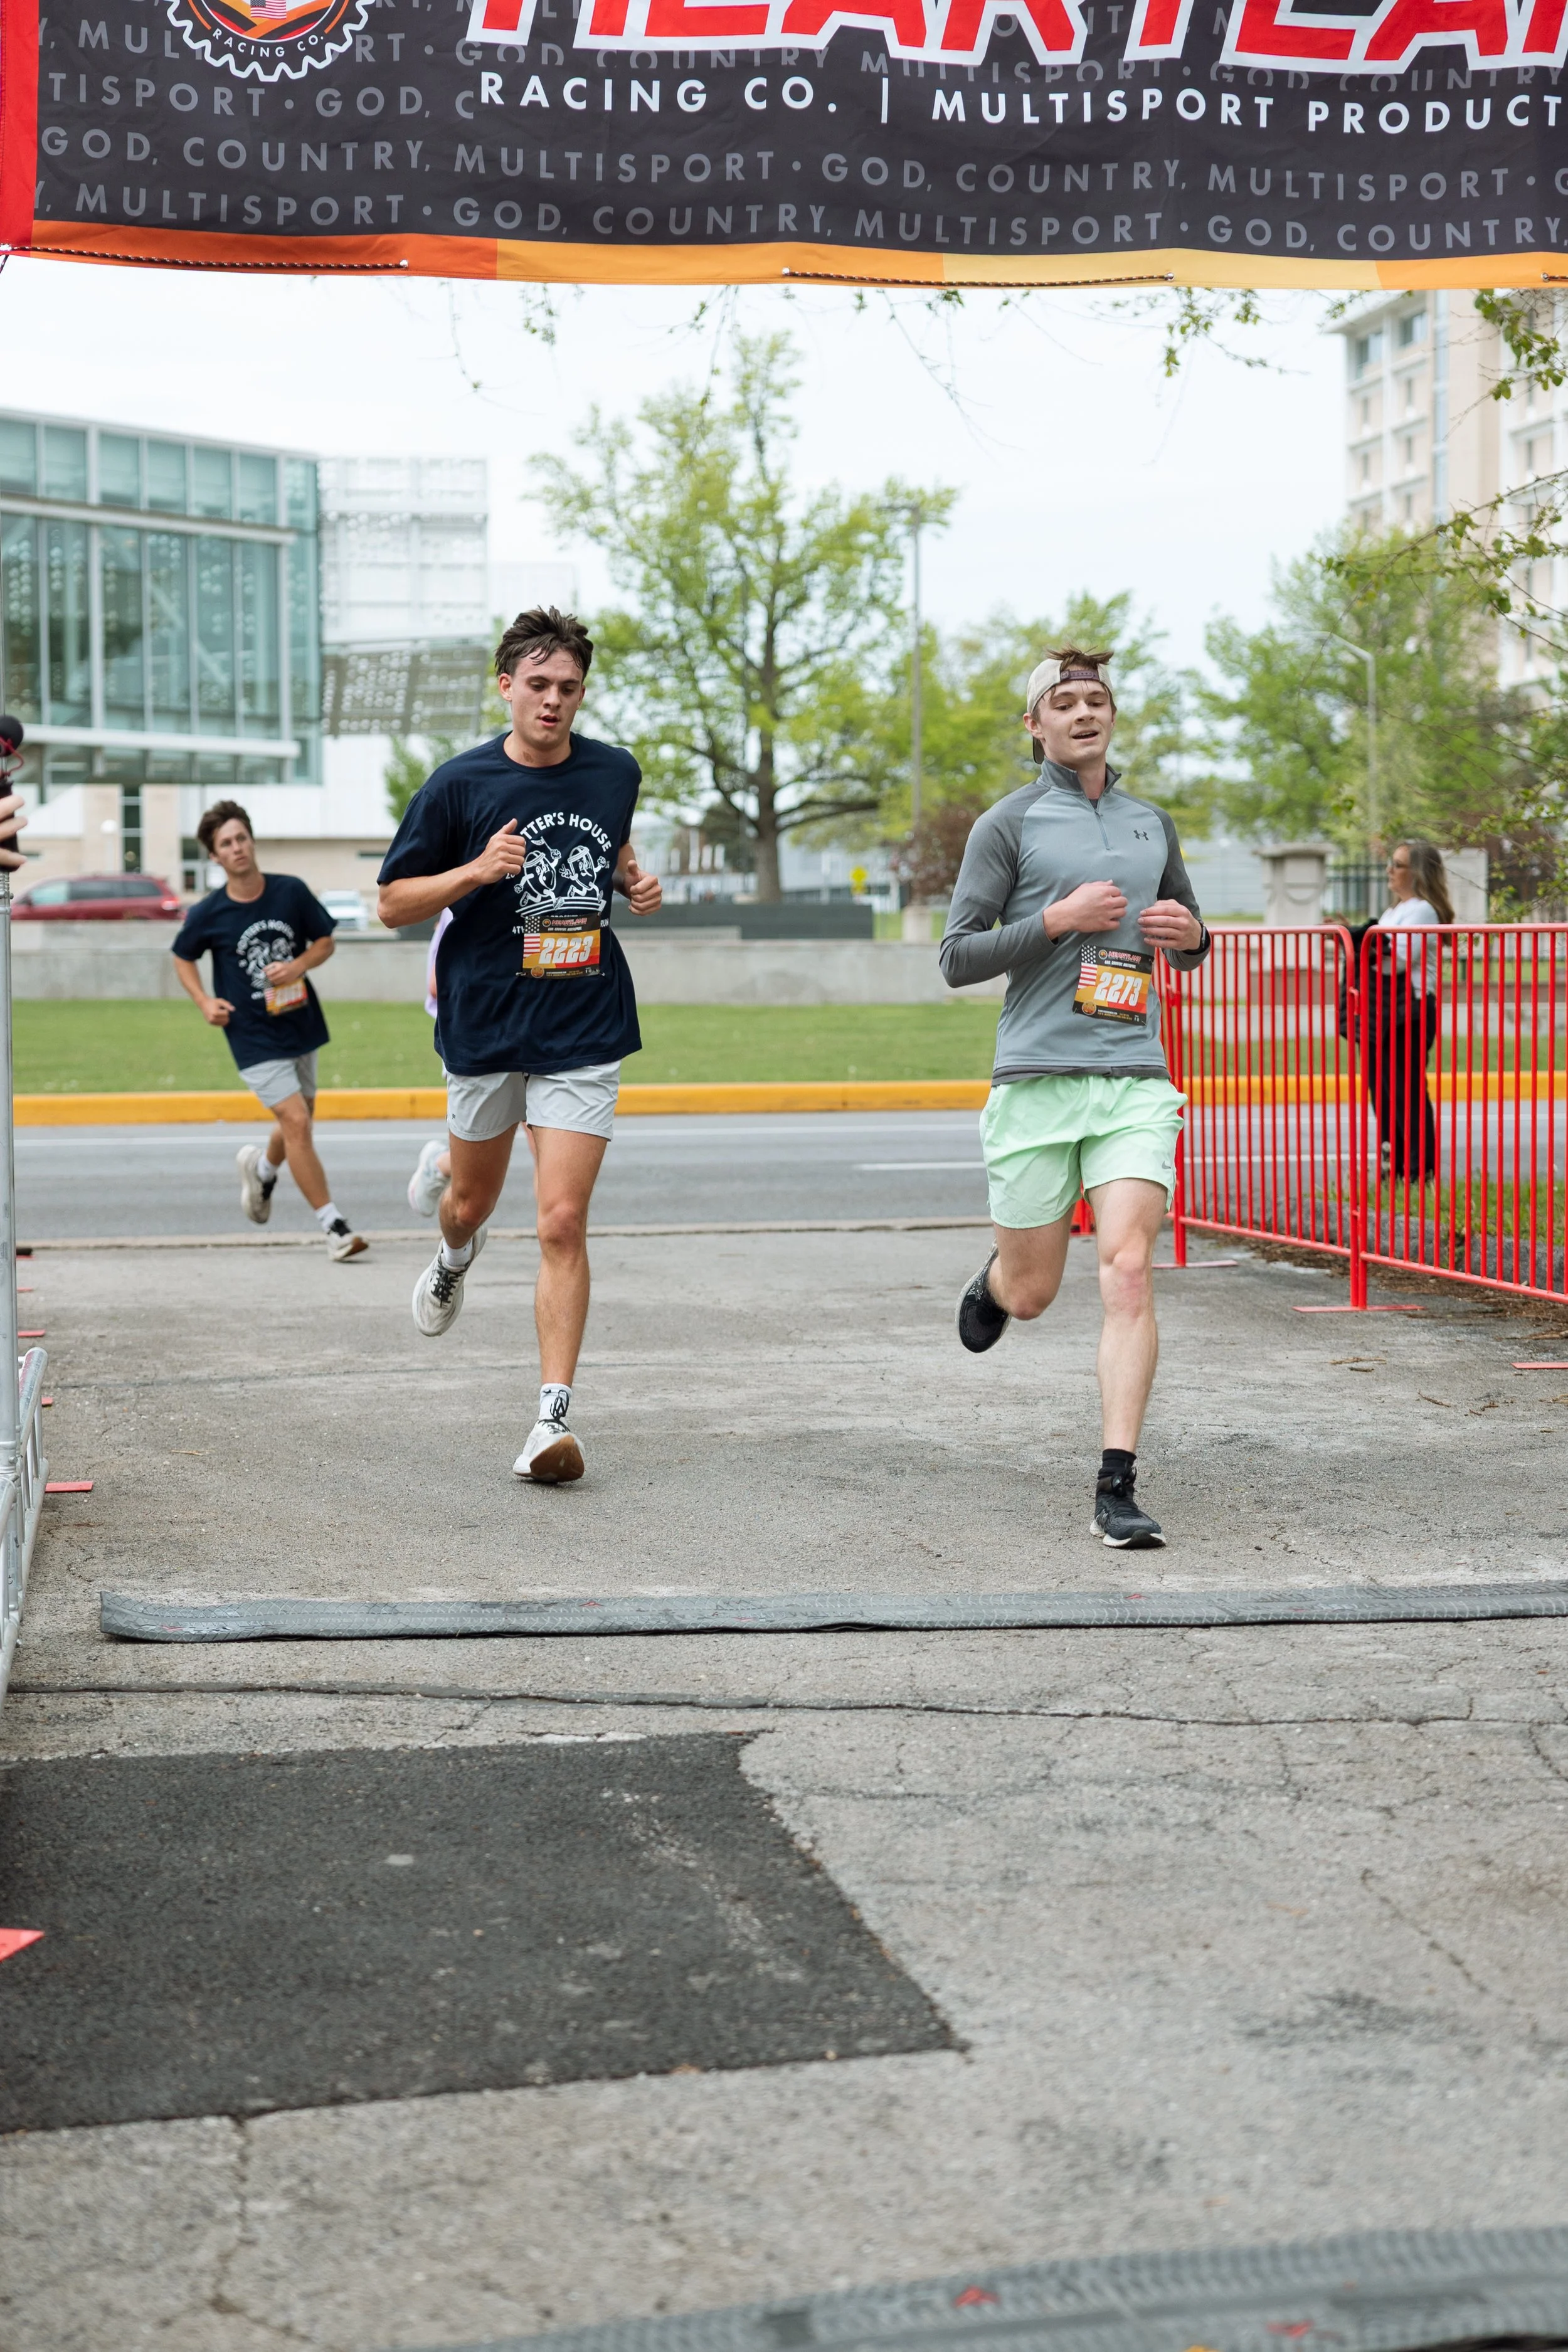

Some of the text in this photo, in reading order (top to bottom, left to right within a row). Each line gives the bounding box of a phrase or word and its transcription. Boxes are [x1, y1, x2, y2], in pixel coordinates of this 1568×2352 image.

[213, 28, 285, 58] RACING
[316, 87, 430, 118] GOD,
[481, 71, 1562, 134] RACING CO. MULTISPORT PRODUCT
[41, 127, 157, 166] GOD,
[183, 140, 430, 172] COUNTRY,
[454, 144, 773, 183] MULTISPORT
[822, 153, 931, 191] GOD,
[956, 159, 1186, 193] COUNTRY,
[1208, 164, 1508, 202] MULTISPORT
[76, 183, 404, 226] MULTISPORT
[453, 198, 568, 235] GOD,
[593, 203, 832, 237] COUNTRY,
[854, 210, 1162, 245] MULTISPORT
[1208, 215, 1315, 252] GOD,
[520, 812, 612, 852] TTER'S HOUSE
[539, 935, 593, 964] 2223
[1093, 972, 1143, 1006] 2273
